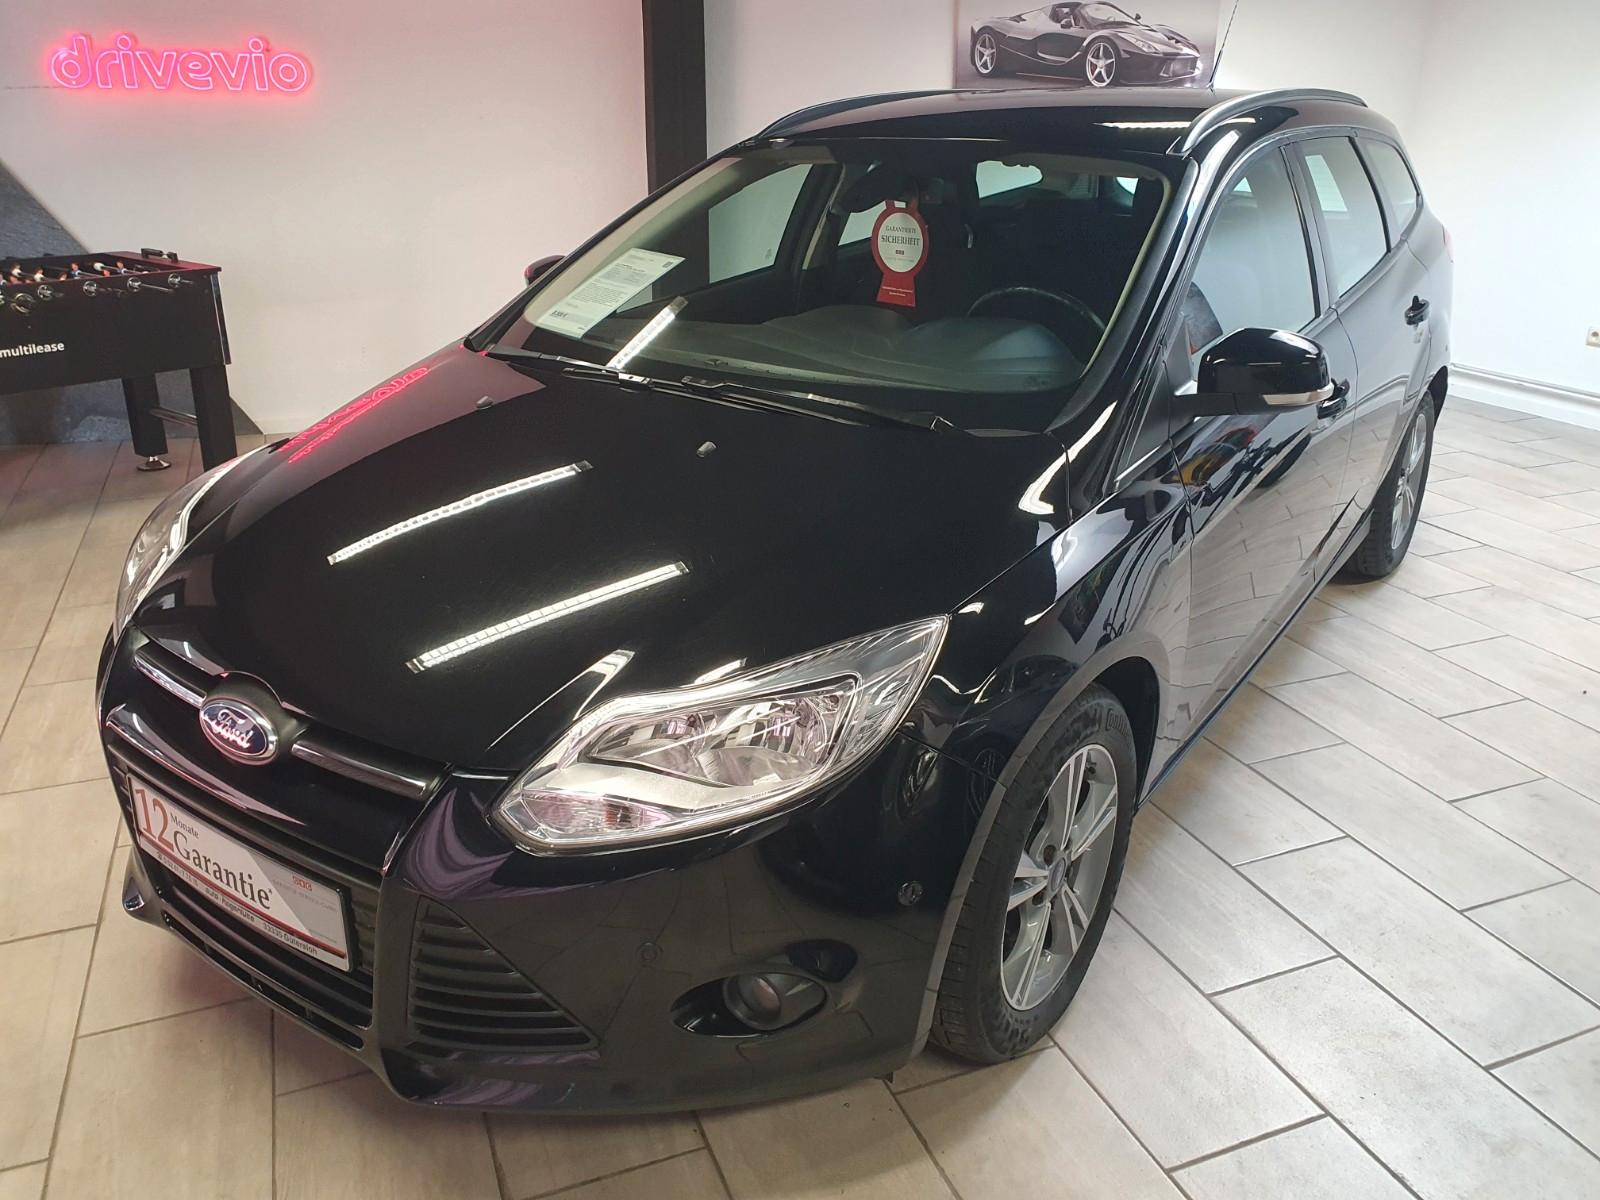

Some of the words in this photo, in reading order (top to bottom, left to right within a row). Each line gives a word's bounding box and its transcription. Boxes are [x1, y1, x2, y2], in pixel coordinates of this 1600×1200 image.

[50, 34, 308, 92] drivevio
[881, 235, 921, 247] SICHERHEIT
[0, 342, 65, 358] multilease
[205, 709, 254, 749] Ford
[135, 788, 175, 852] 12
[170, 812, 200, 840] Monate
